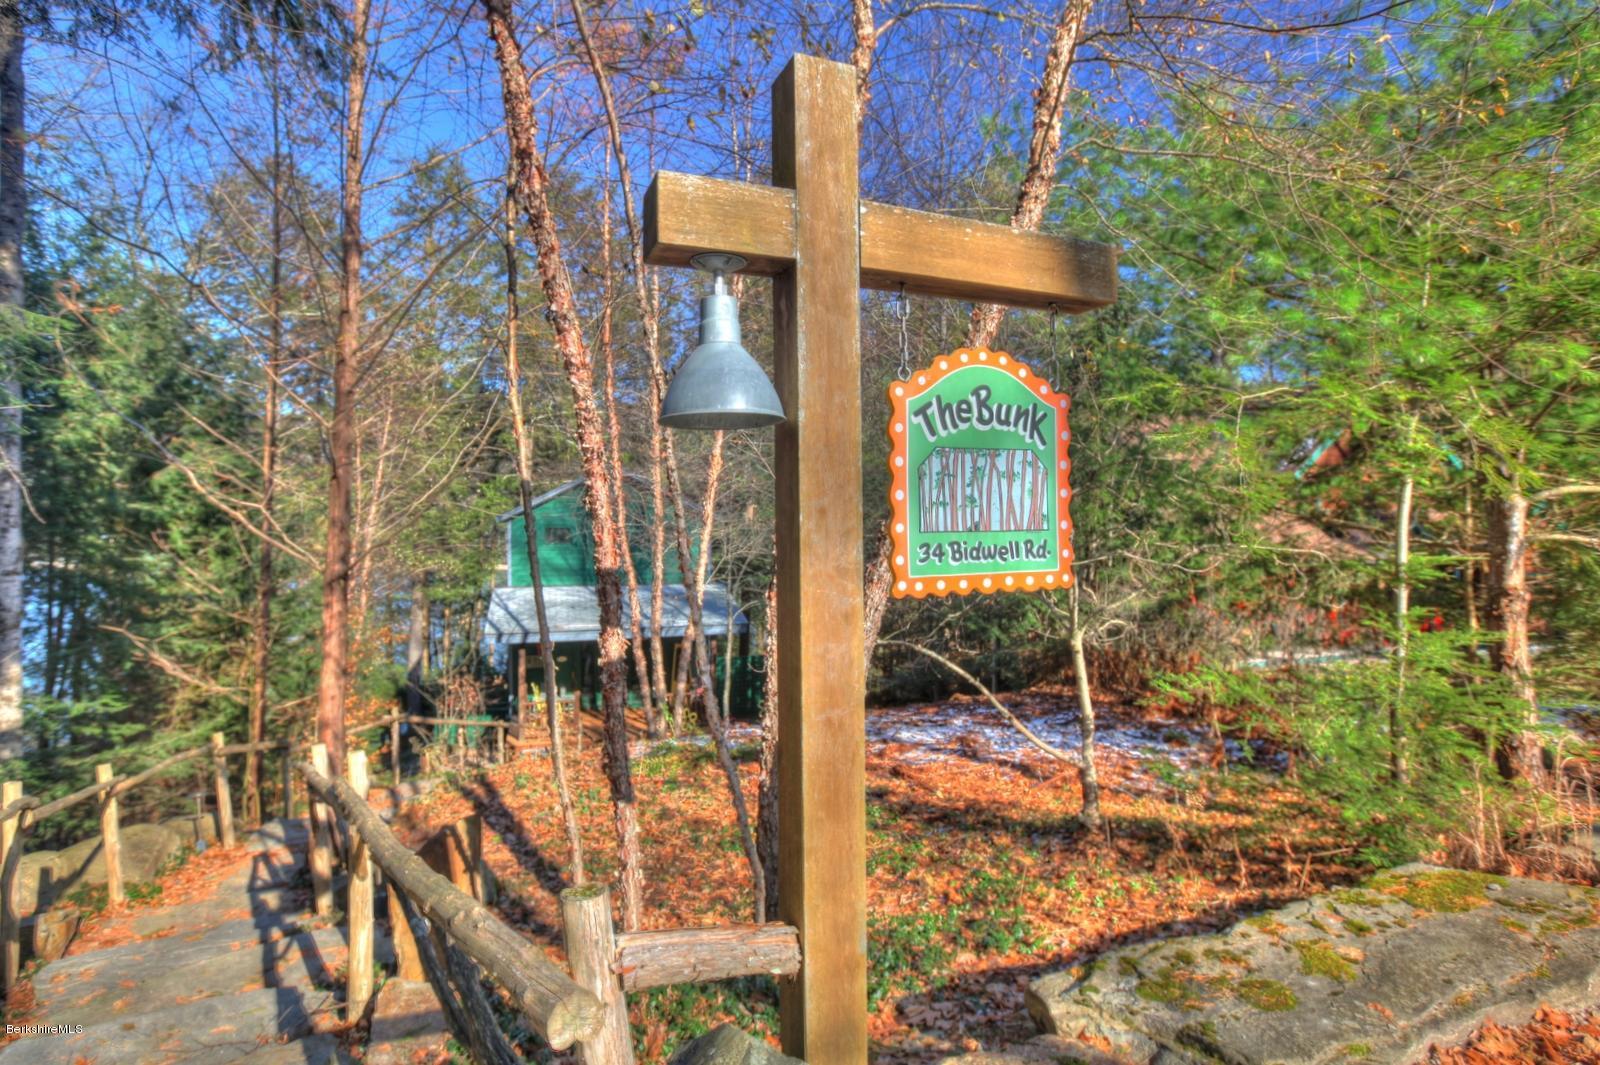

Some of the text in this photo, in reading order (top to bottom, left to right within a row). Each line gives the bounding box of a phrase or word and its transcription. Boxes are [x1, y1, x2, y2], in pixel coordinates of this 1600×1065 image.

[918, 538, 1051, 564] 34 Bidwell Rd.
